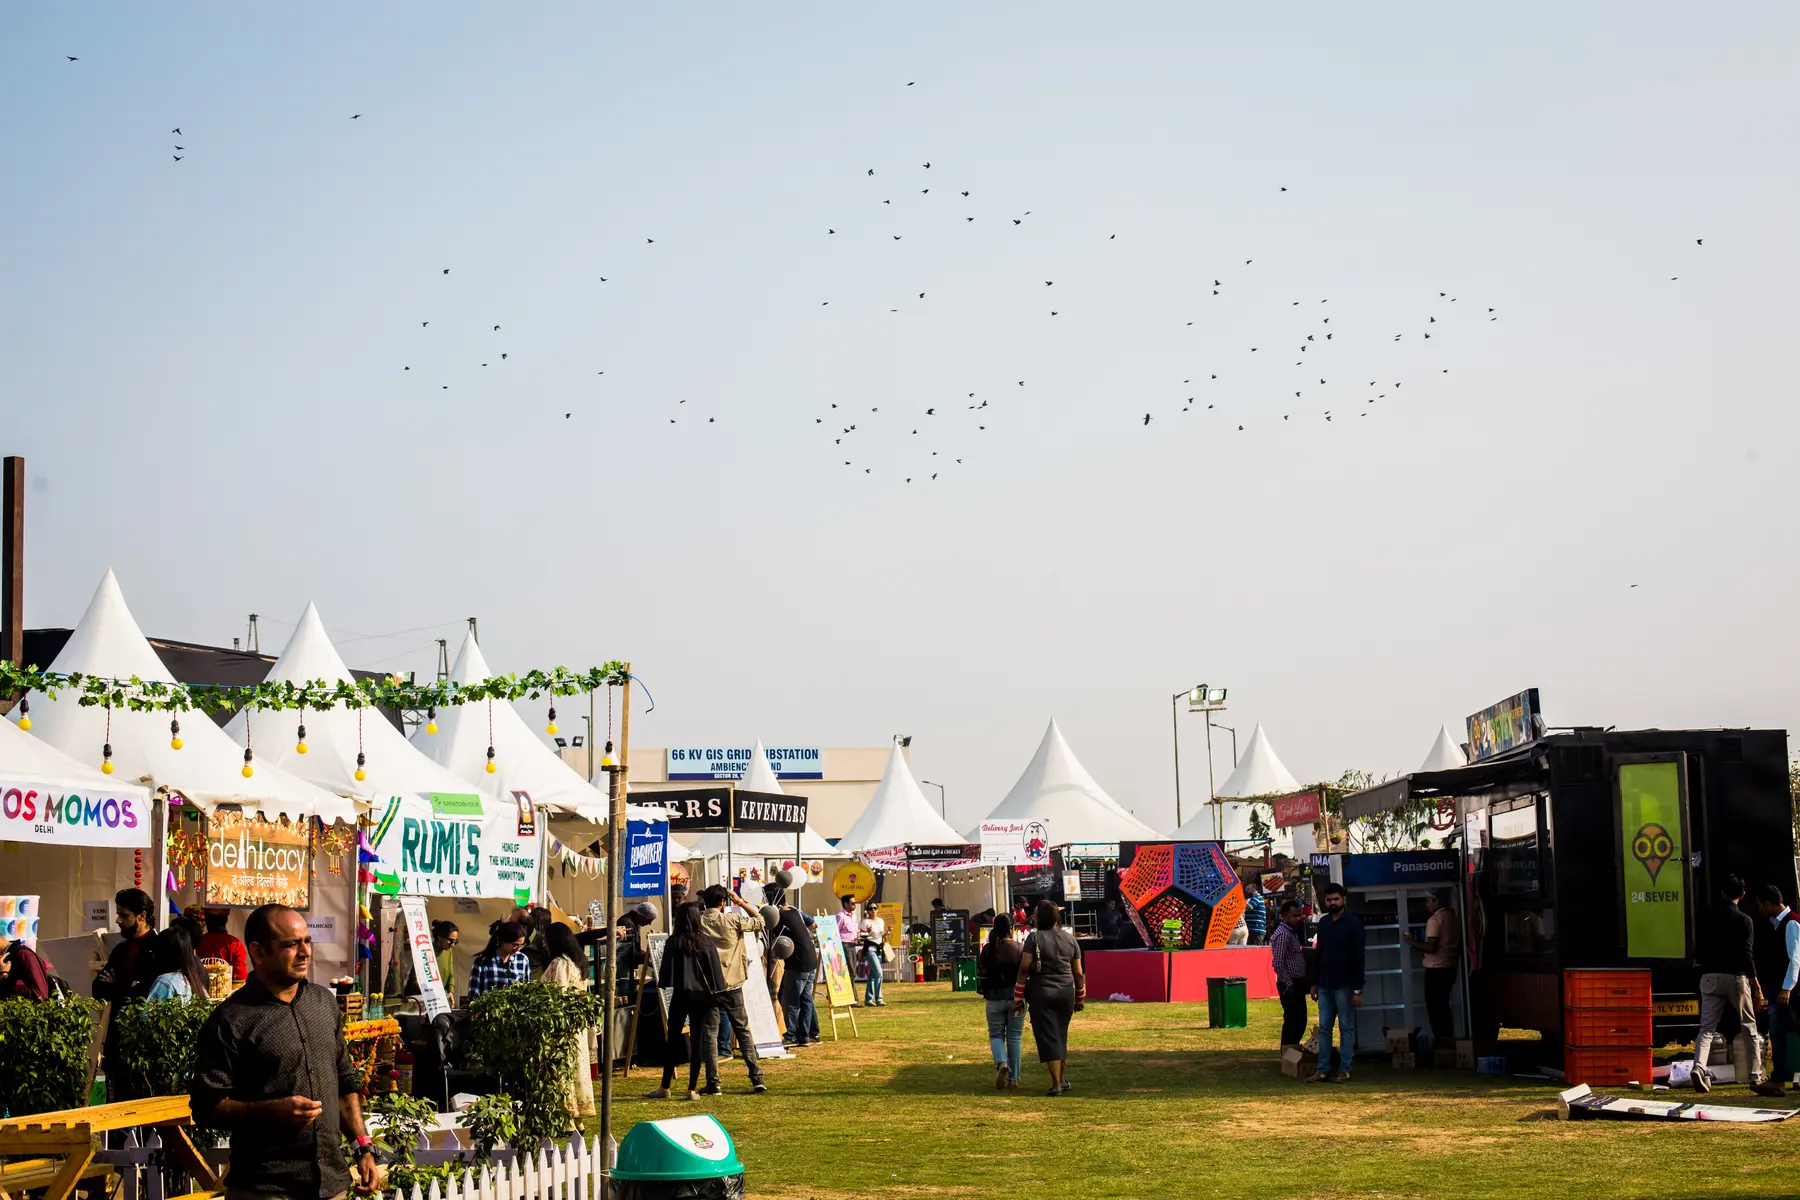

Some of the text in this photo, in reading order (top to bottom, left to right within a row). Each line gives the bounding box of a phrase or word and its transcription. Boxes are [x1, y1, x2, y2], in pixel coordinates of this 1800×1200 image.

[671, 749, 818, 761] 66 KV GIS GRID UBSTATION
[710, 762, 749, 771] AMBIENC
[0, 787, 138, 828] OS MOMOS
[740, 800, 806, 823] KEVENTERS
[35, 824, 54, 834] DELHI
[982, 824, 1024, 833] Delivery Jack
[402, 817, 481, 876] RUMI'S
[489, 855, 499, 866] THE
[1393, 860, 1454, 872] Panasonic
[402, 877, 482, 895] KITCHEN
[1631, 891, 1679, 902] 24SEVEN
[1676, 1004, 1693, 1012] 3761
